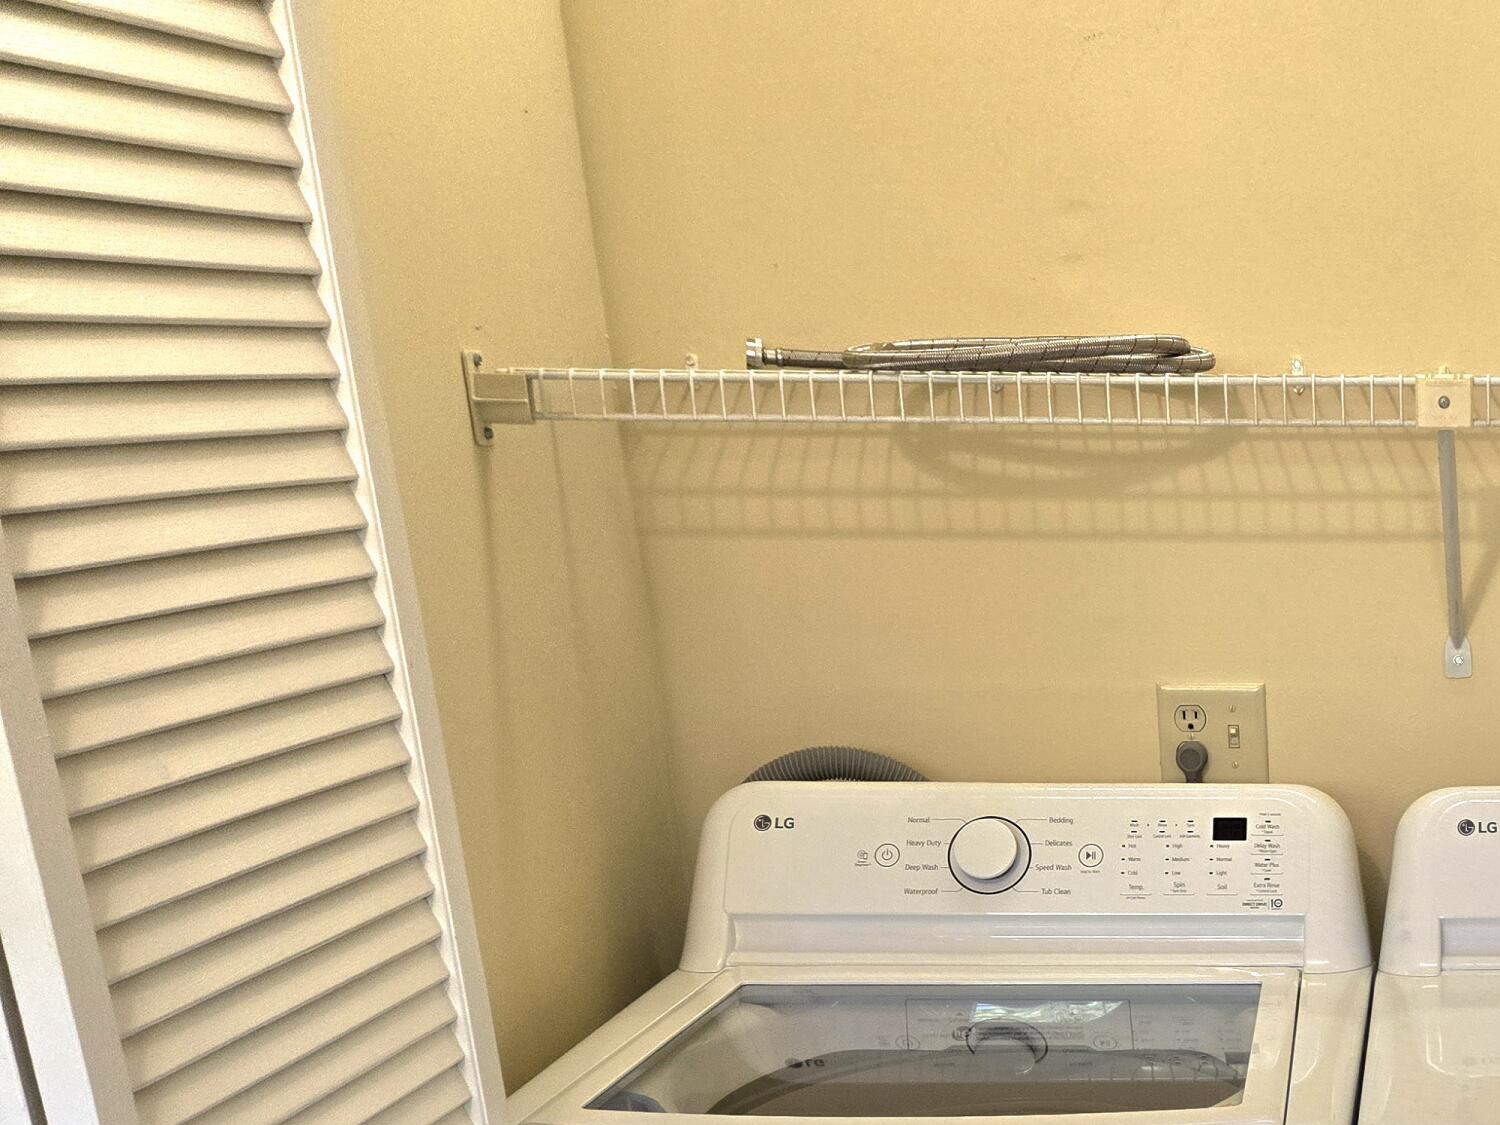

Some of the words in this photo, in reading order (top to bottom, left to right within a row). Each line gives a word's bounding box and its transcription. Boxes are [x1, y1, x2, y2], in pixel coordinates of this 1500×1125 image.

[774, 817, 795, 829] LG
[907, 816, 930, 824] Normal
[1049, 817, 1074, 825] Bedding
[1478, 821, 1498, 833] LG
[906, 840, 926, 848] Heavy
[926, 840, 942, 848] Duty
[905, 864, 921, 872] Deep
[1035, 864, 1054, 872] Speed
[1173, 881, 1186, 889] Spin
[904, 888, 939, 896] Waterproof
